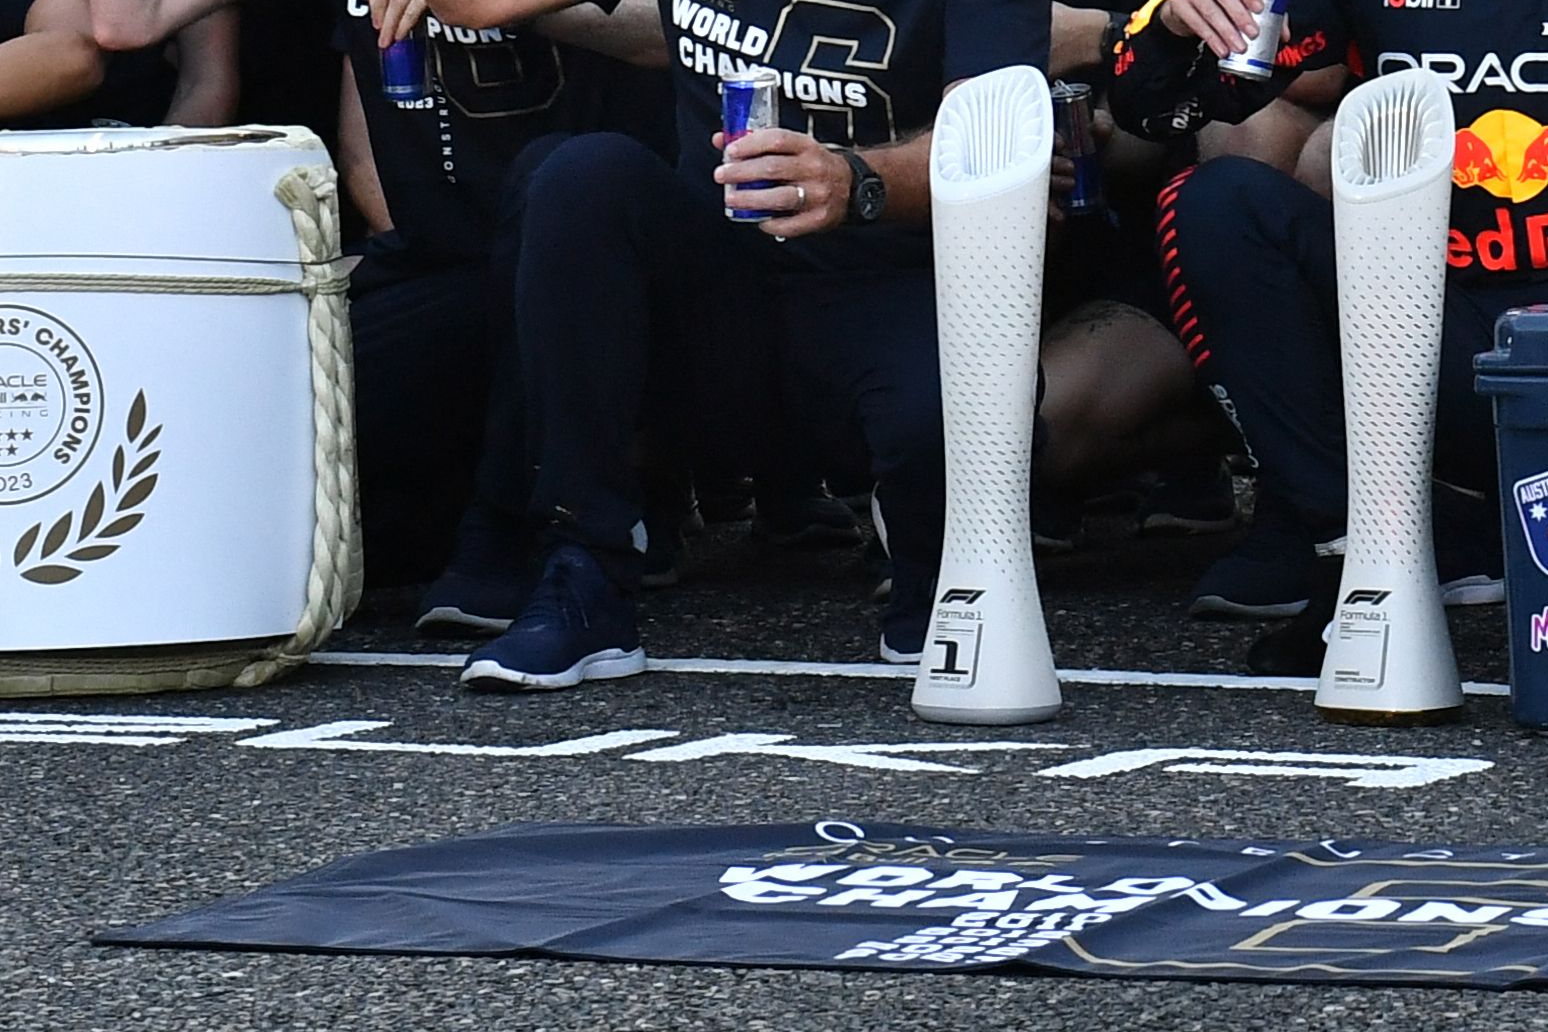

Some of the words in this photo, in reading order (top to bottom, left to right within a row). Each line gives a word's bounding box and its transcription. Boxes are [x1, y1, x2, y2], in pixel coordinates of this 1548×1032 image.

[1447, 207, 1517, 271] ed
[0, 374, 47, 387] ACLE
[35, 328, 90, 465] CHAMPIONS
[0, 473, 33, 492] 23
[936, 609, 976, 620] Formula
[1340, 610, 1380, 621] Formula
[930, 640, 969, 675] 1
[719, 864, 1196, 896] WORLD
